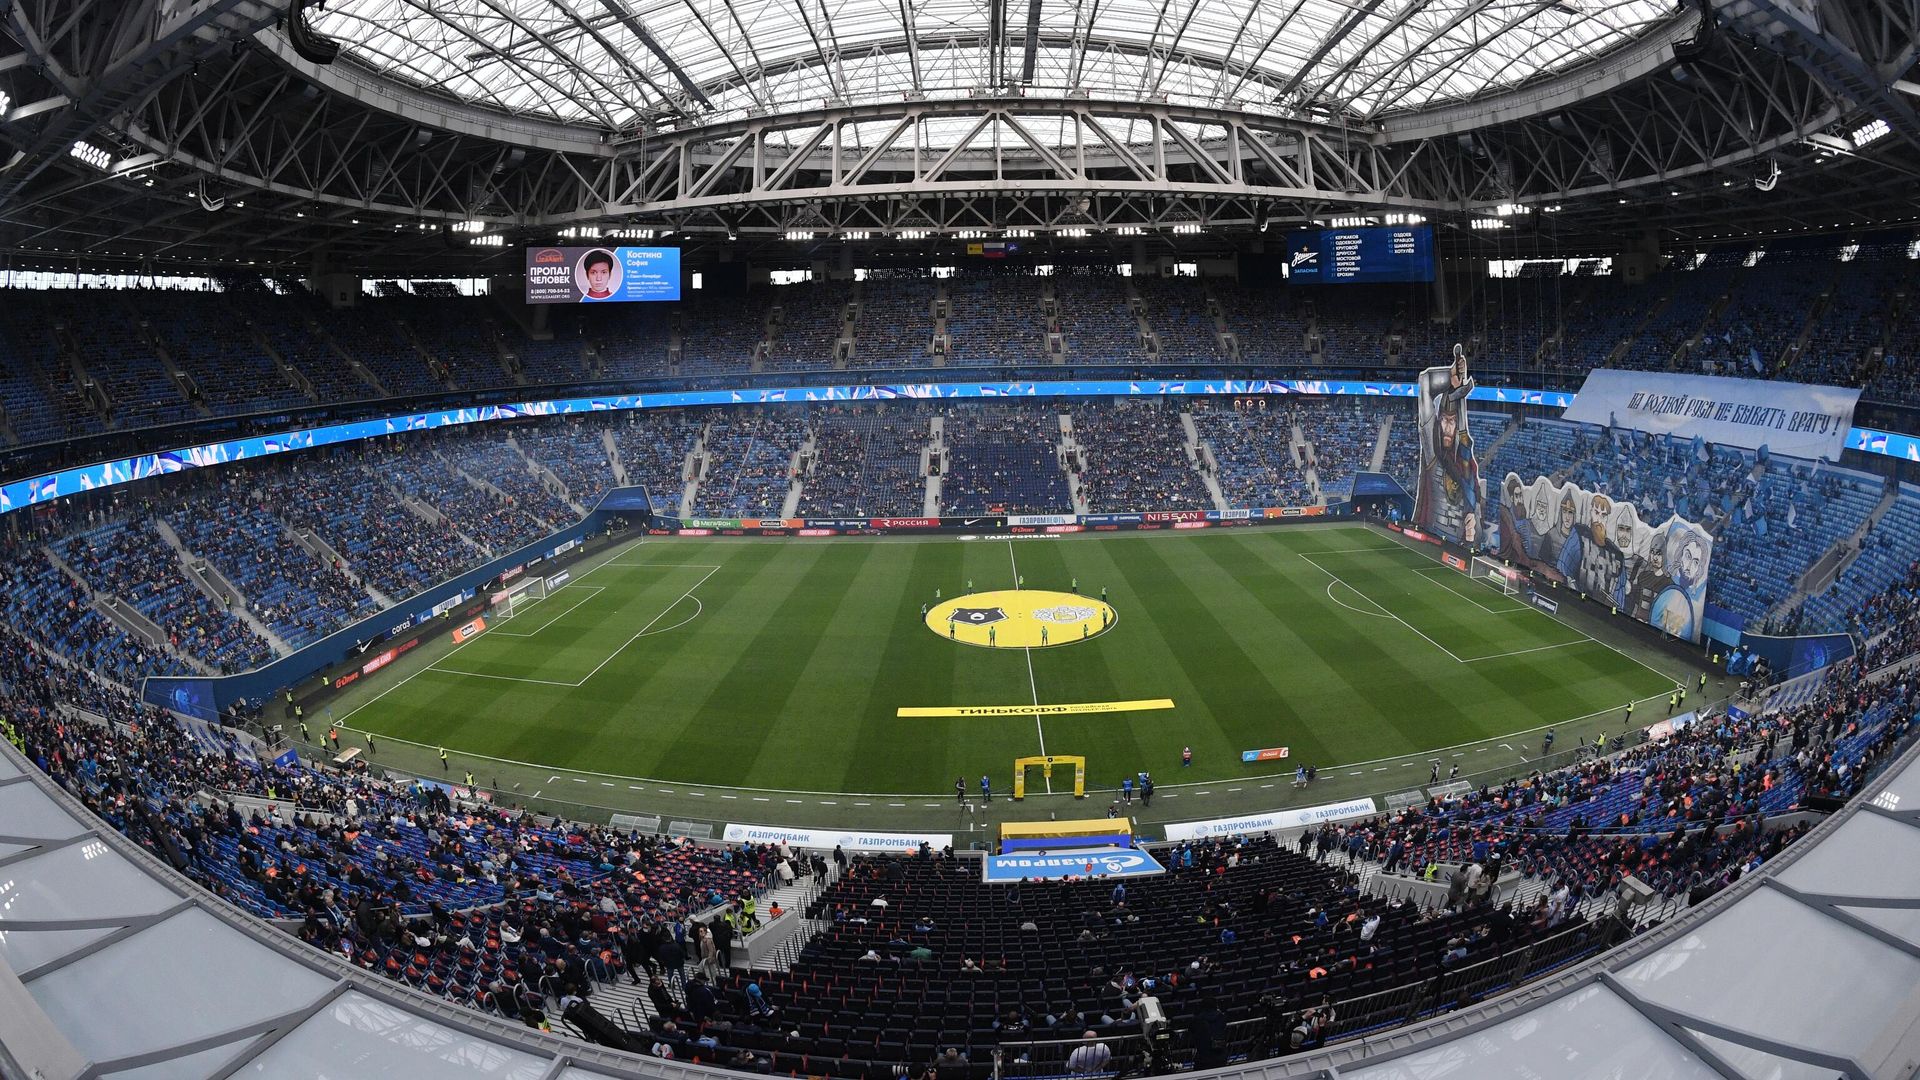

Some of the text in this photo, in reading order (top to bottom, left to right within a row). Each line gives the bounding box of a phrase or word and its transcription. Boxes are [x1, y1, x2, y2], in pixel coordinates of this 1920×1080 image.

[627, 250, 663, 259] Костина
[627, 259, 648, 267] София
[530, 266, 570, 276] ПРОПАЛ
[530, 276, 571, 284] ЧЕЛОВЕК
[1627, 392, 1645, 409] НА
[1643, 394, 1689, 416] РОДНОЙ
[1686, 398, 1716, 419] РУСИ
[1714, 402, 1733, 421] НЕ
[1731, 403, 1788, 430] БЫВАТЬ
[1787, 411, 1832, 435] ВРАГУ
[1147, 512, 1198, 521] NISSAN
[957, 706, 1068, 715] ТИНЬКОФФ
[1315, 803, 1371, 820] ГАЗПРОМБАНК
[1213, 818, 1274, 833] ГАЗПРОМБАНК
[747, 830, 811, 842] ГАЗПРОМБАНК
[858, 837, 925, 847] ГАЗПРОМБАНК
[996, 857, 1099, 868] ГАЗПРОМ
